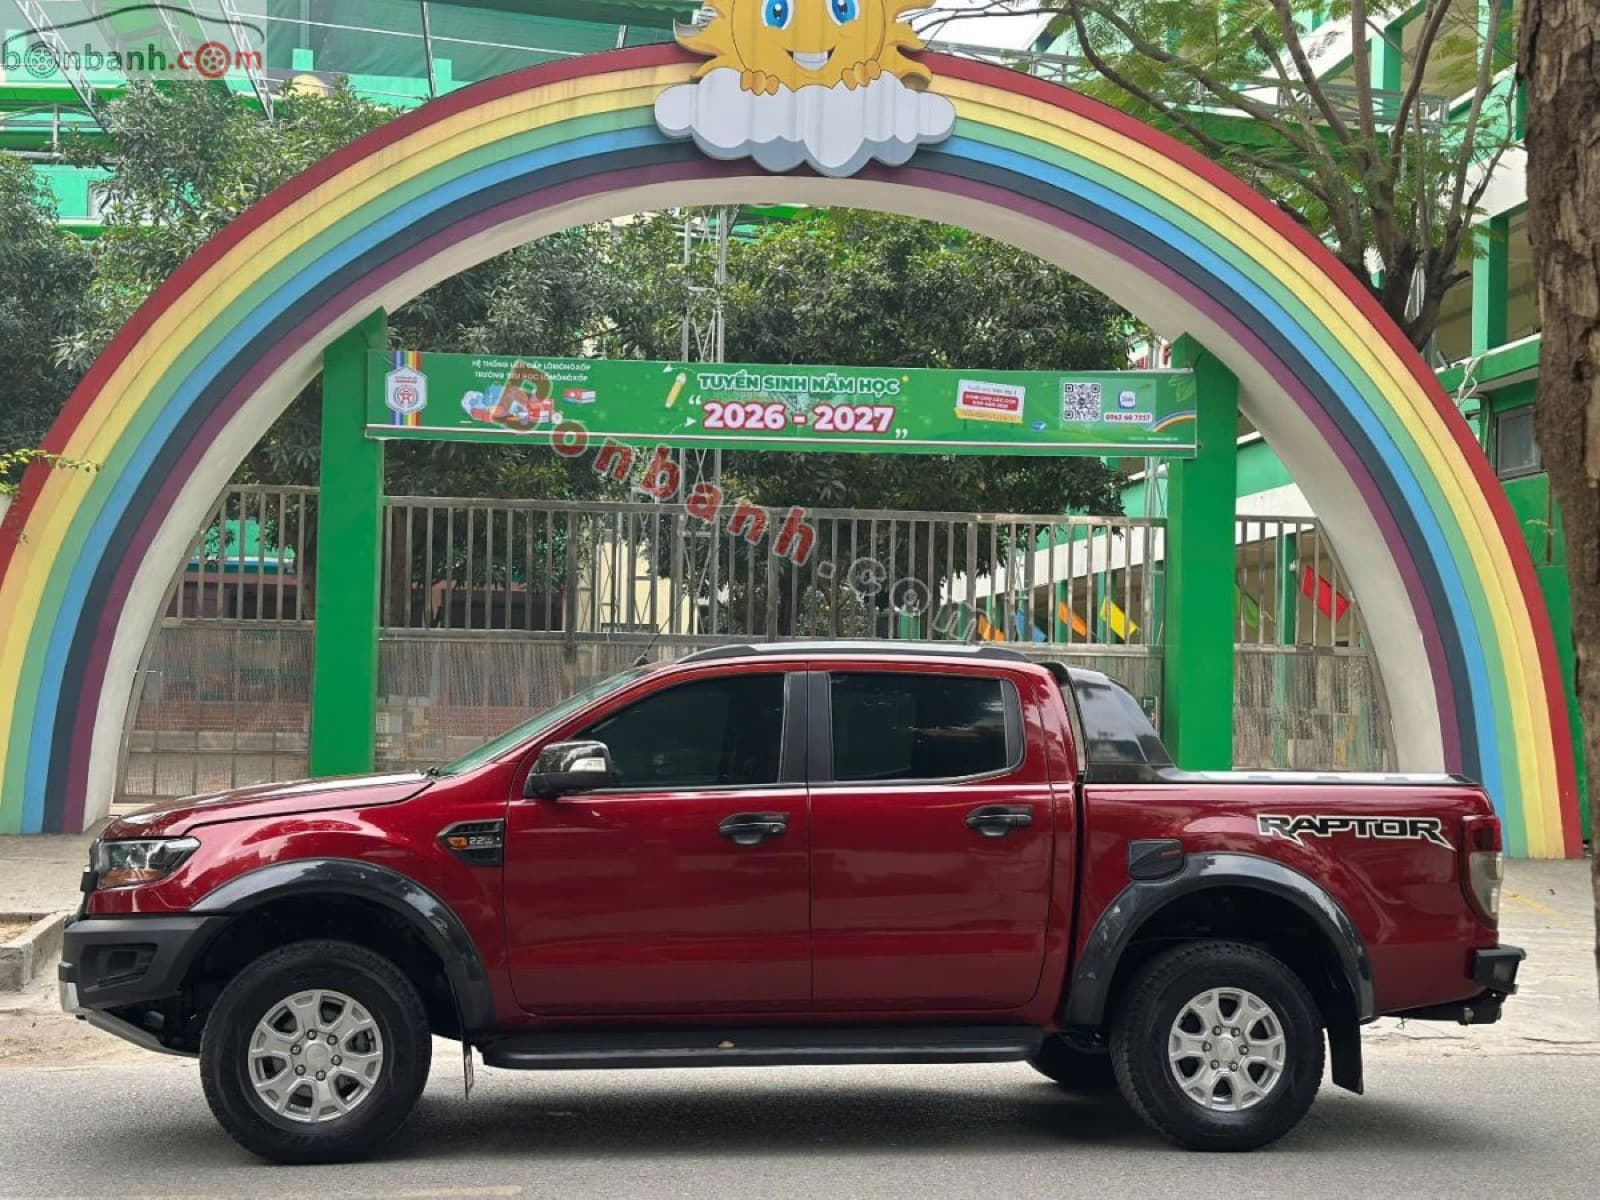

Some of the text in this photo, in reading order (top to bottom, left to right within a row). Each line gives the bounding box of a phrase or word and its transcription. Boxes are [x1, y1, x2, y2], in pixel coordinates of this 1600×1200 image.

[698, 370, 900, 399] TUYỂN SINH NĂM HỌC
[1256, 812, 1456, 851] RAPTOR
